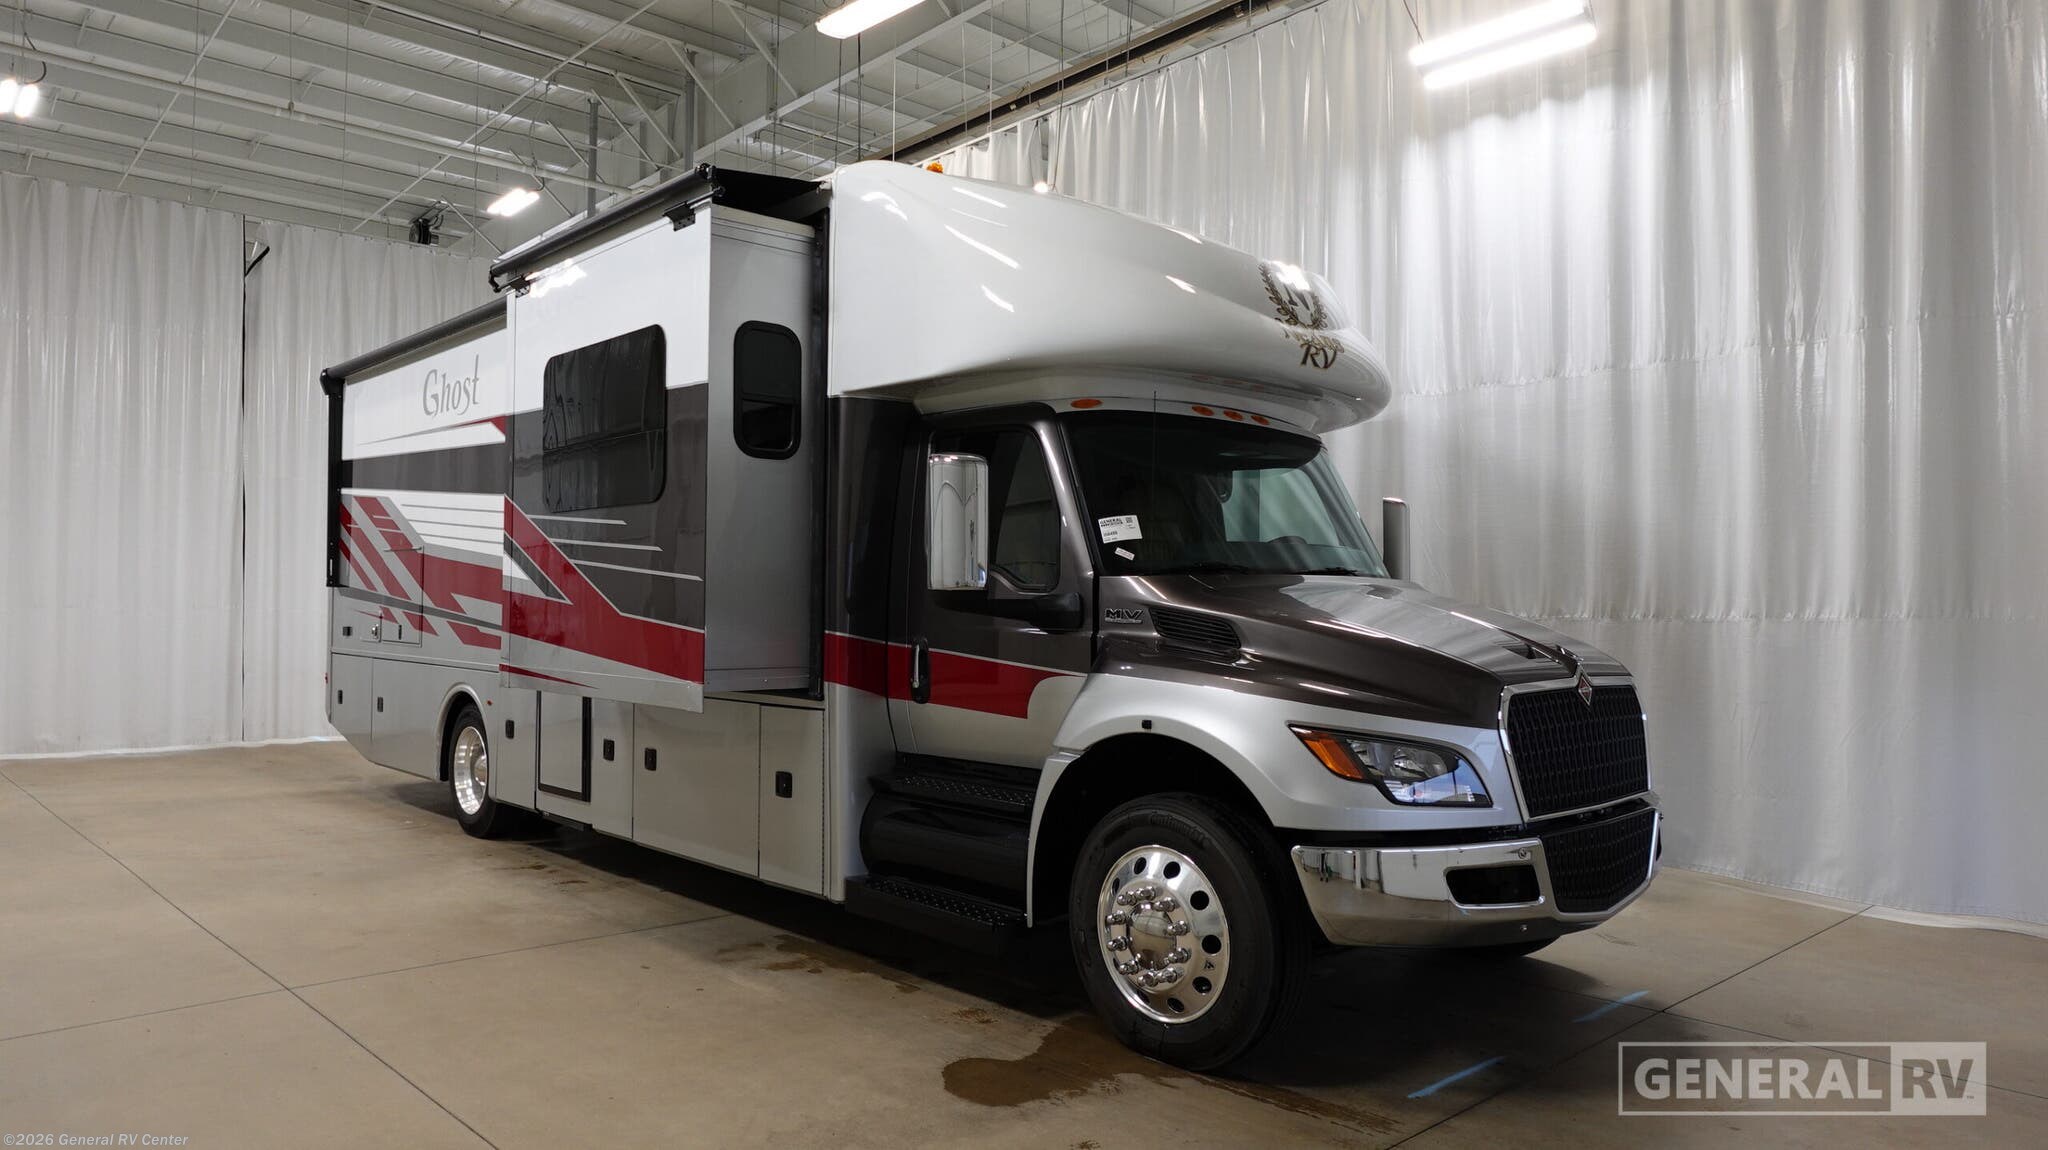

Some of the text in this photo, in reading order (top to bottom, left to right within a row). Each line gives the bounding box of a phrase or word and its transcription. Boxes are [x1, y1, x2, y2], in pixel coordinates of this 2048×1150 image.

[1300, 343, 1337, 369] RV
[423, 354, 479, 417] Ghost
[1105, 608, 1144, 620] MV
